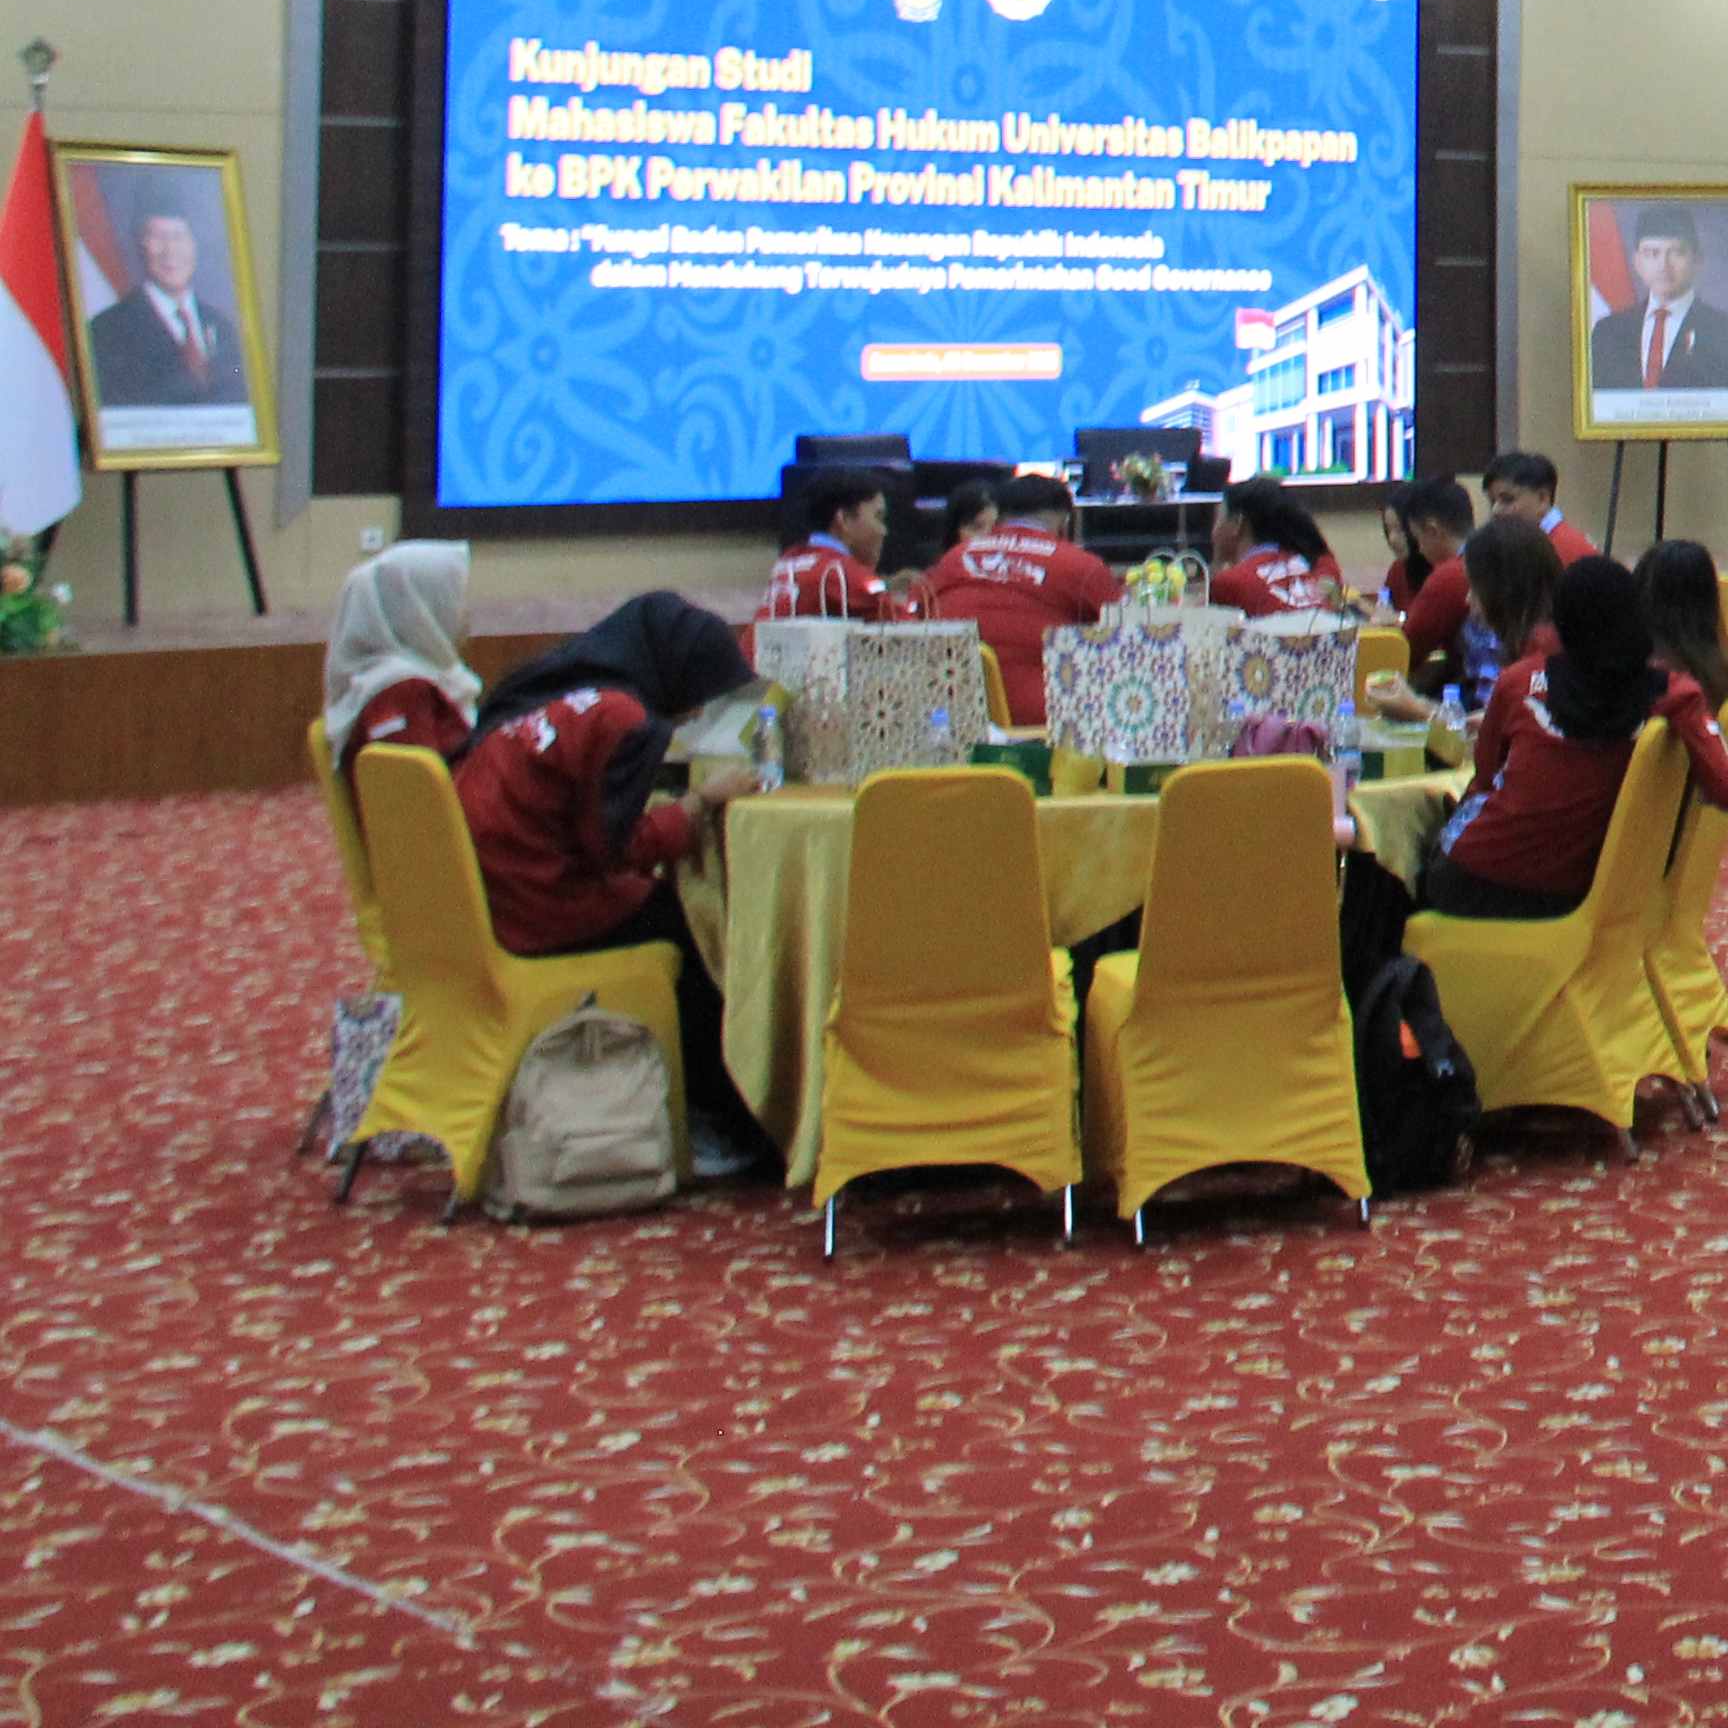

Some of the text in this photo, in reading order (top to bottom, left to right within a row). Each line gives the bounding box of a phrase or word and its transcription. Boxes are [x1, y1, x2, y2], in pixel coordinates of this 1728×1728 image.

[510, 37, 813, 95] Kunjungan Studi
[508, 95, 1358, 167] Mahasiswa Fakultas Hukum Universitas Balikpapan
[506, 152, 1272, 211] ke BPK Perwakilan Provinsi Kalimantan Timur
